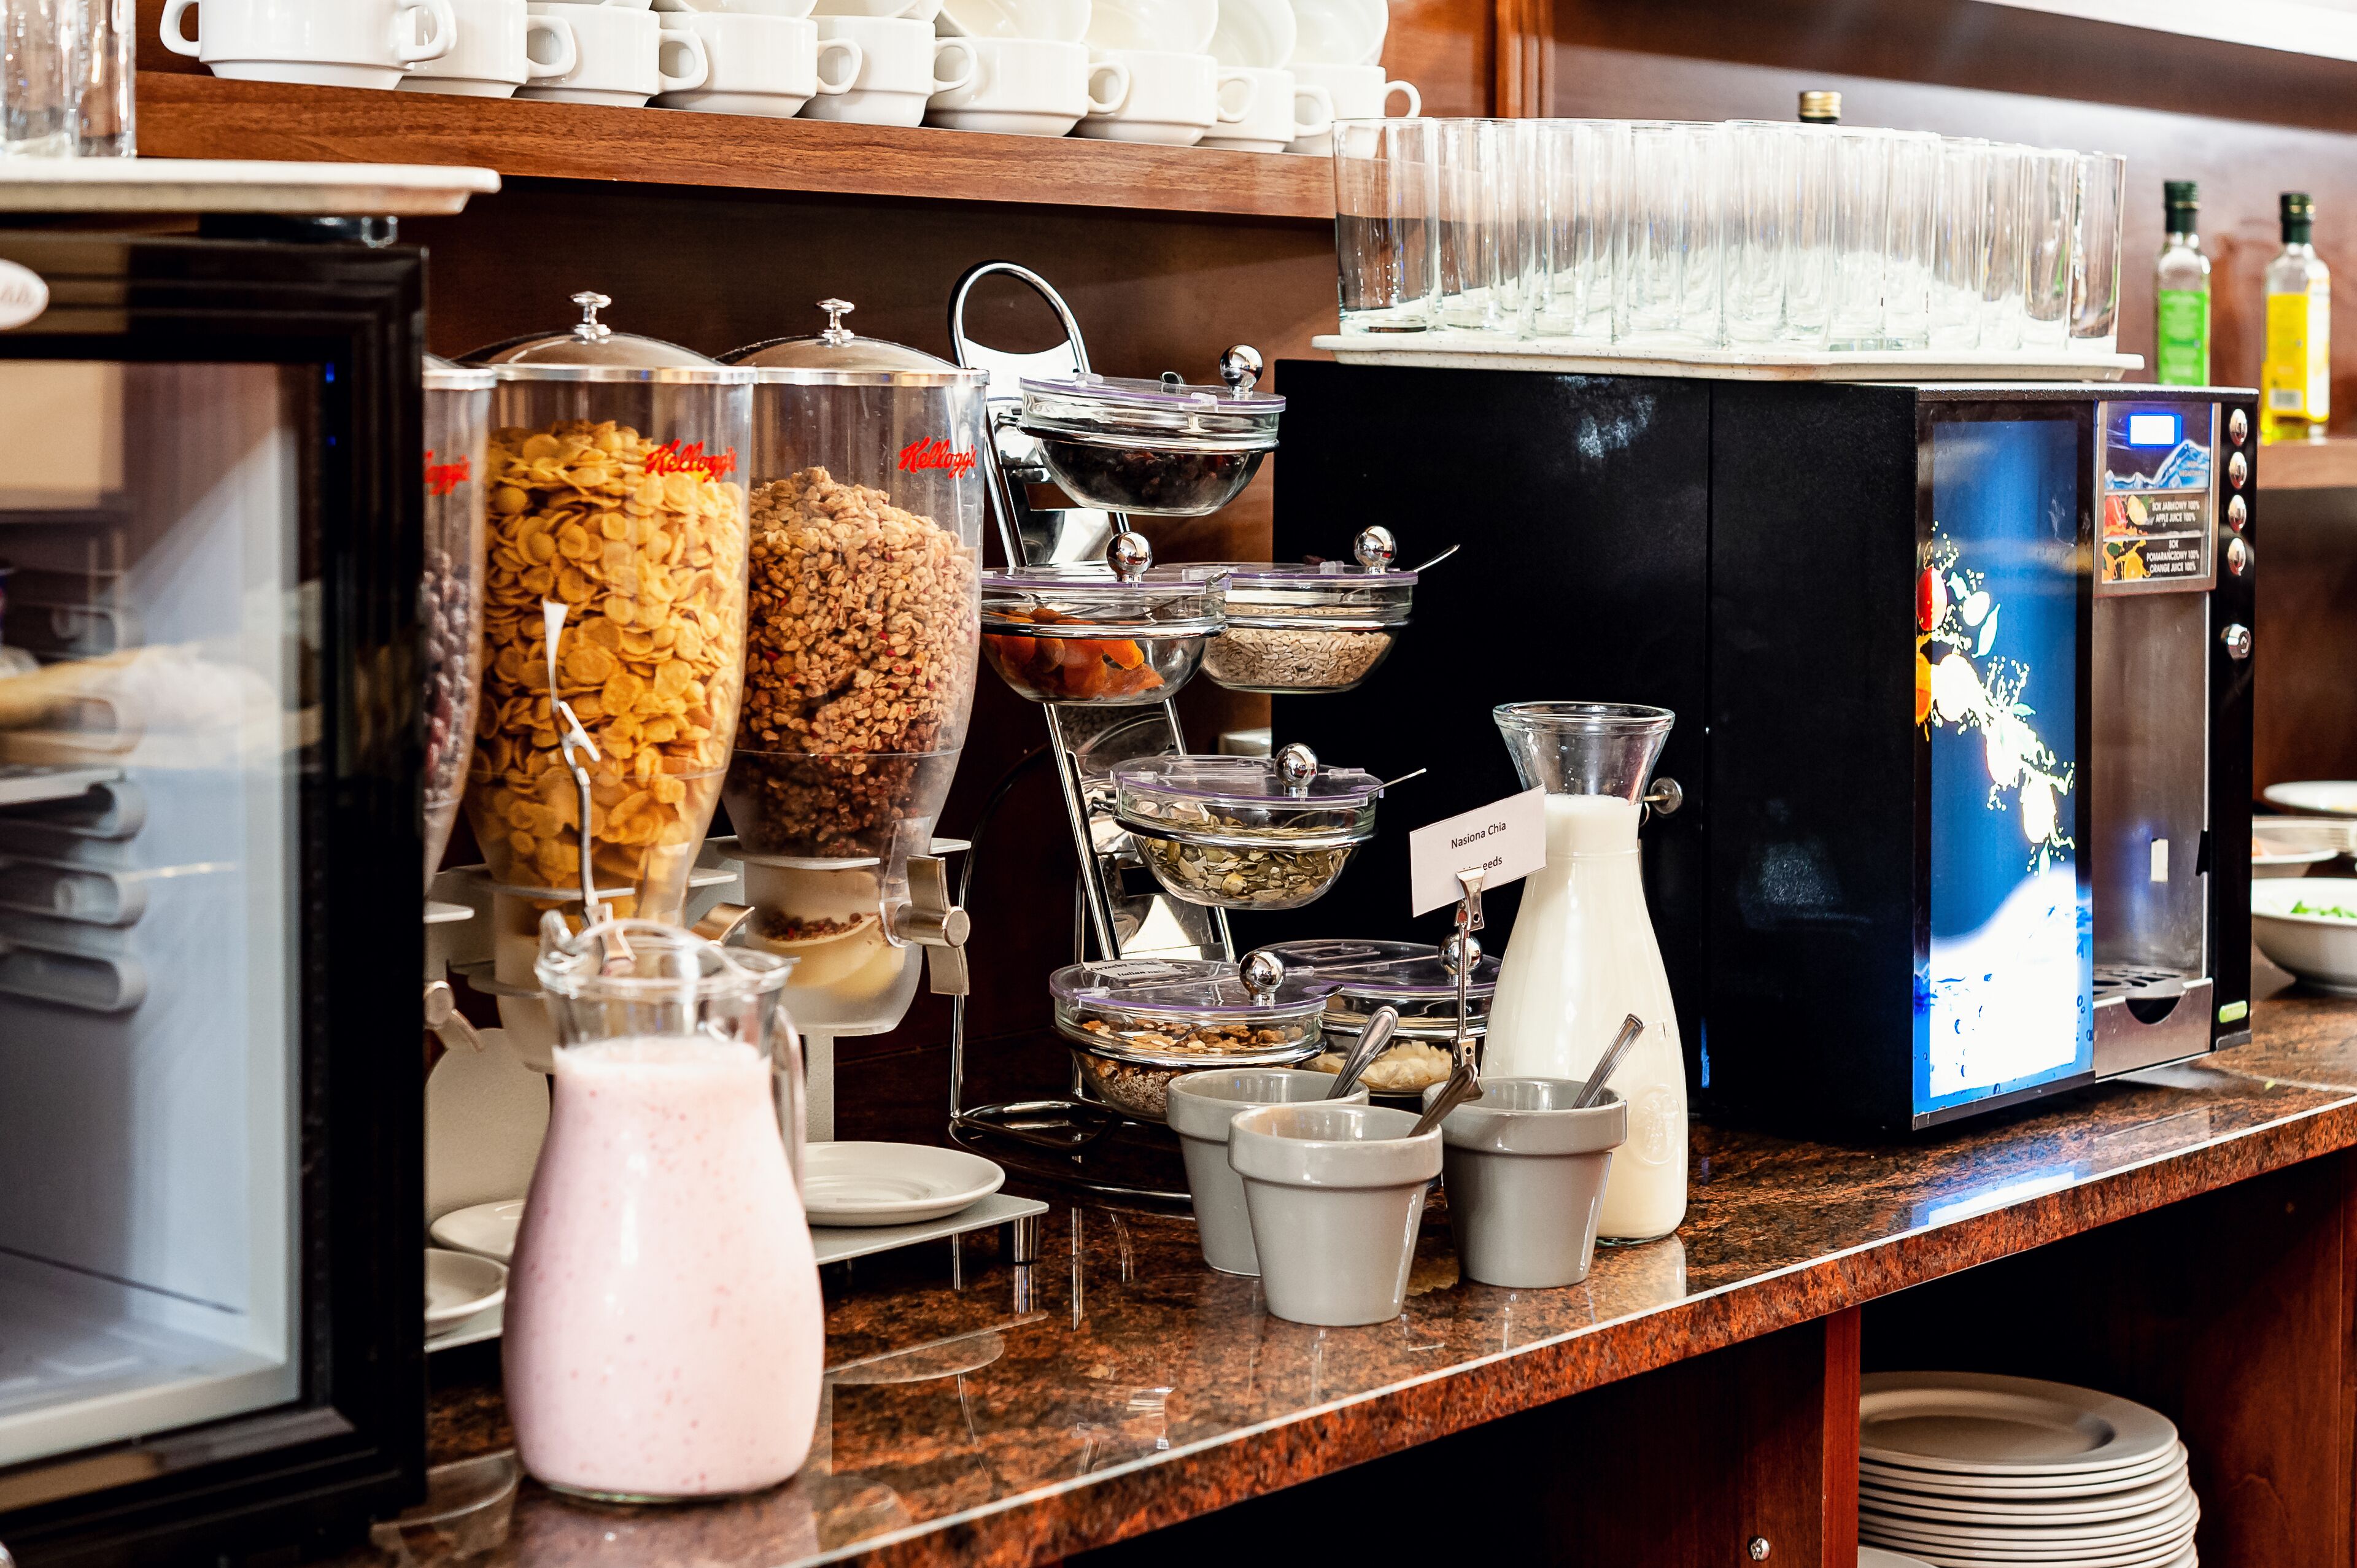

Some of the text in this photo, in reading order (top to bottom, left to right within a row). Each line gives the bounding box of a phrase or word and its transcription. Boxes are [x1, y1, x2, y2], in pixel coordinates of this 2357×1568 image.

[645, 438, 737, 482] Kellogg's
[897, 436, 977, 479] Kellogg's
[2156, 512, 2169, 523] APPLE
[2169, 512, 2183, 522] JUICE
[2169, 539, 2179, 549] SOK
[2150, 563, 2170, 573] ORANGE
[2170, 562, 2183, 572] JUICE
[1451, 822, 1506, 849] Nasiona Chia
[1483, 856, 1503, 871] eeds
